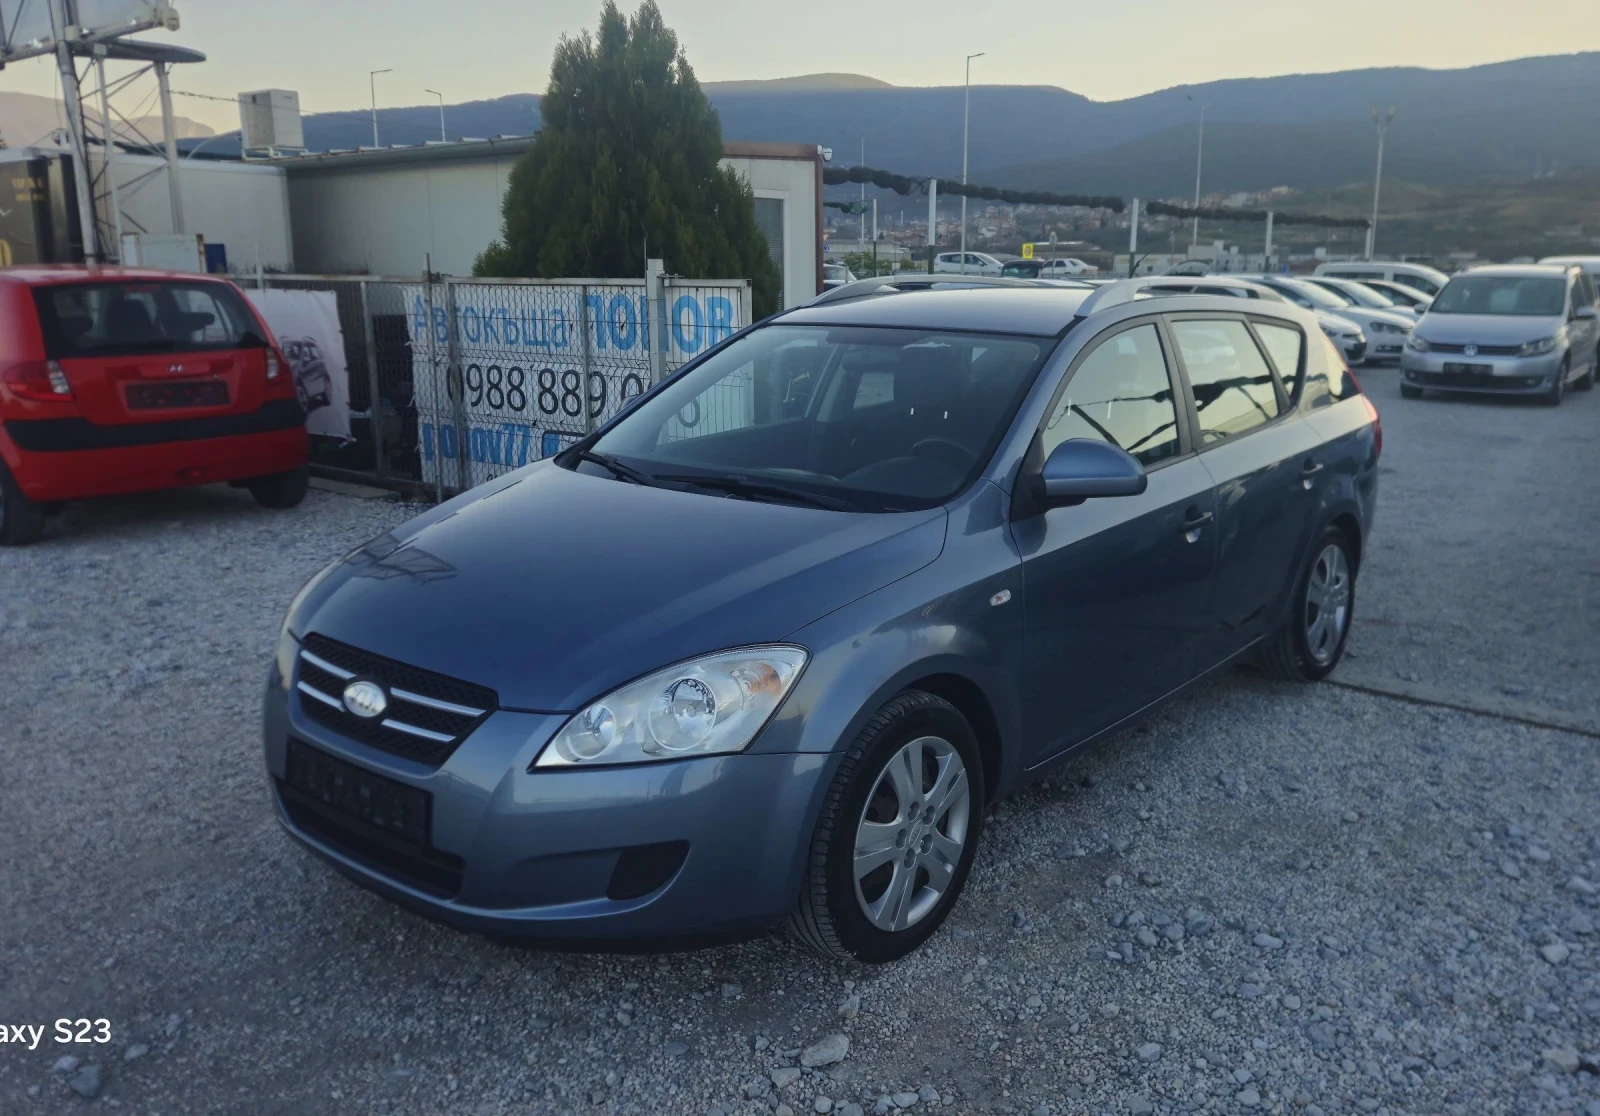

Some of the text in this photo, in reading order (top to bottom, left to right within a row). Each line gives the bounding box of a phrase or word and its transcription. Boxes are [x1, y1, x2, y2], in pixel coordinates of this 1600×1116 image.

[446, 363, 526, 412] 0988
[537, 368, 607, 418] 889
[422, 423, 531, 467] oov77
